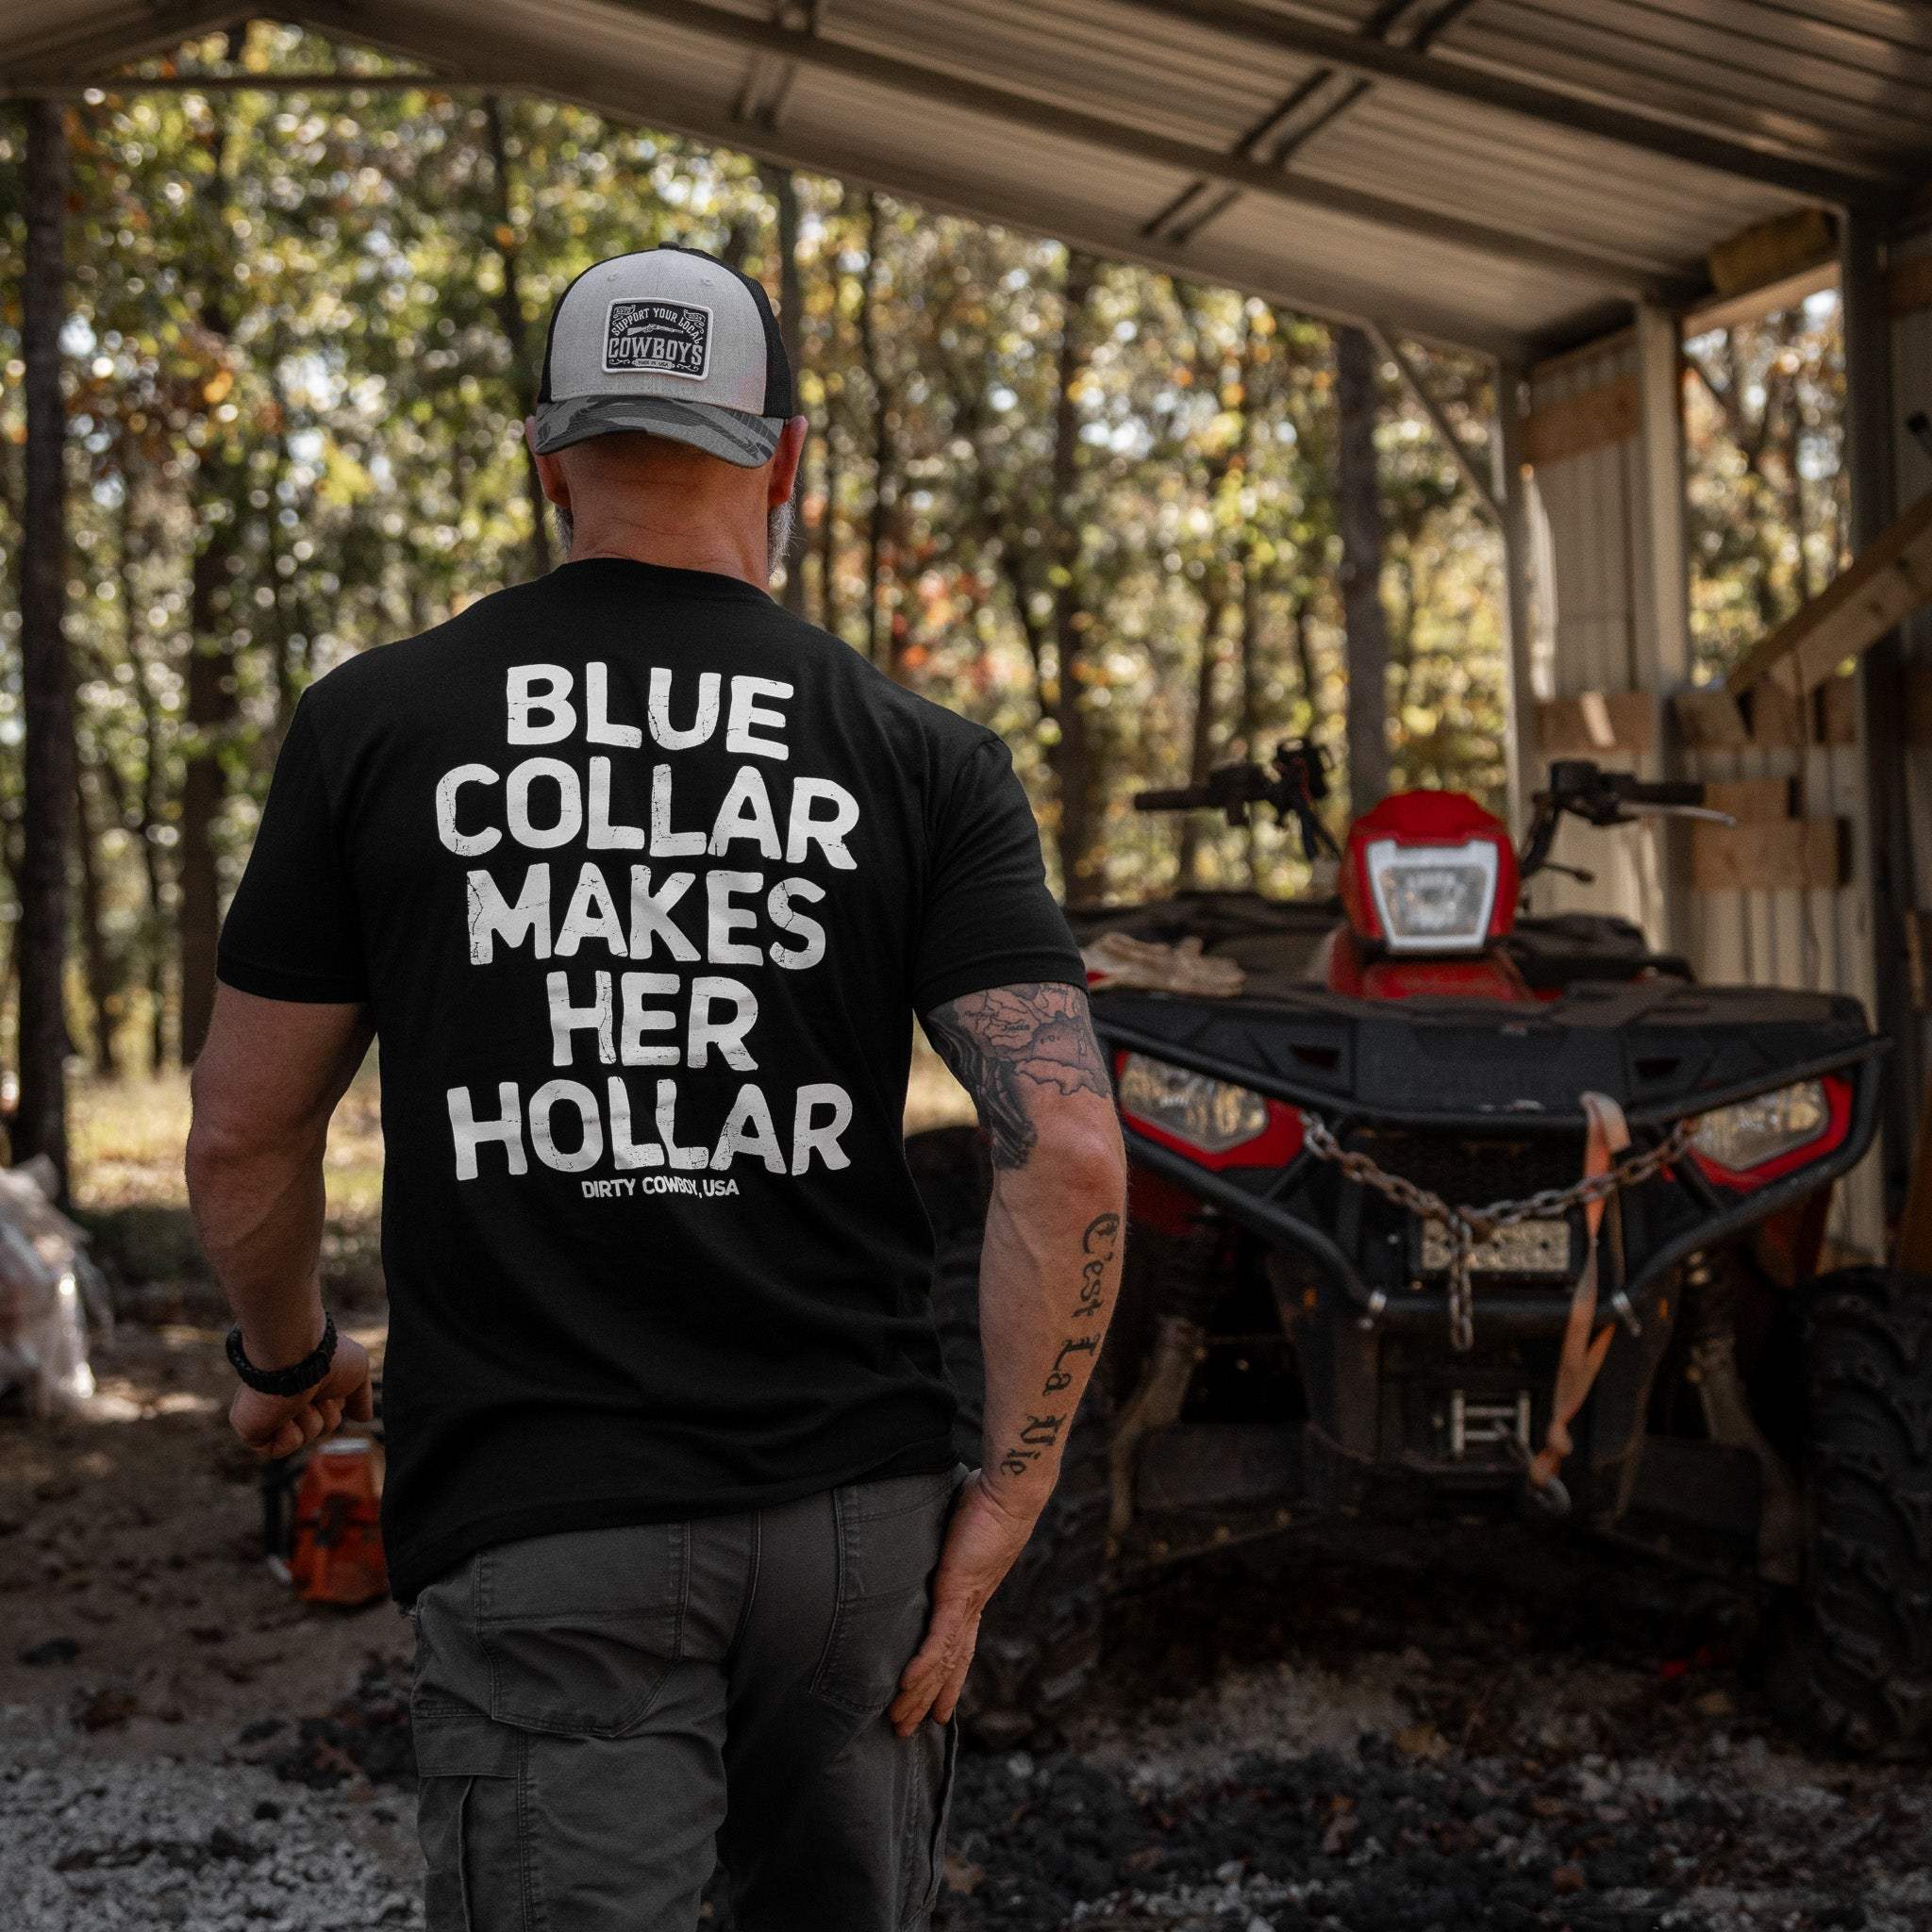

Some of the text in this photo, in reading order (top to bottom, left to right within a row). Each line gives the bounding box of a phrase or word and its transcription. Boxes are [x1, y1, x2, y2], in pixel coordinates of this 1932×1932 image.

[608, 337, 703, 366] COWBOYS
[611, 308, 704, 344] SUPPORT YOUR LOCAL
[507, 661, 793, 760] BLUE
[436, 757, 859, 870] COLLAR
[467, 862, 825, 971] MAKES
[546, 971, 758, 1072] HER
[447, 1076, 852, 1181] HOLLAR
[581, 1175, 741, 1198] DIRTY COWBOY, USA
[1042, 1333, 1102, 1398] La
